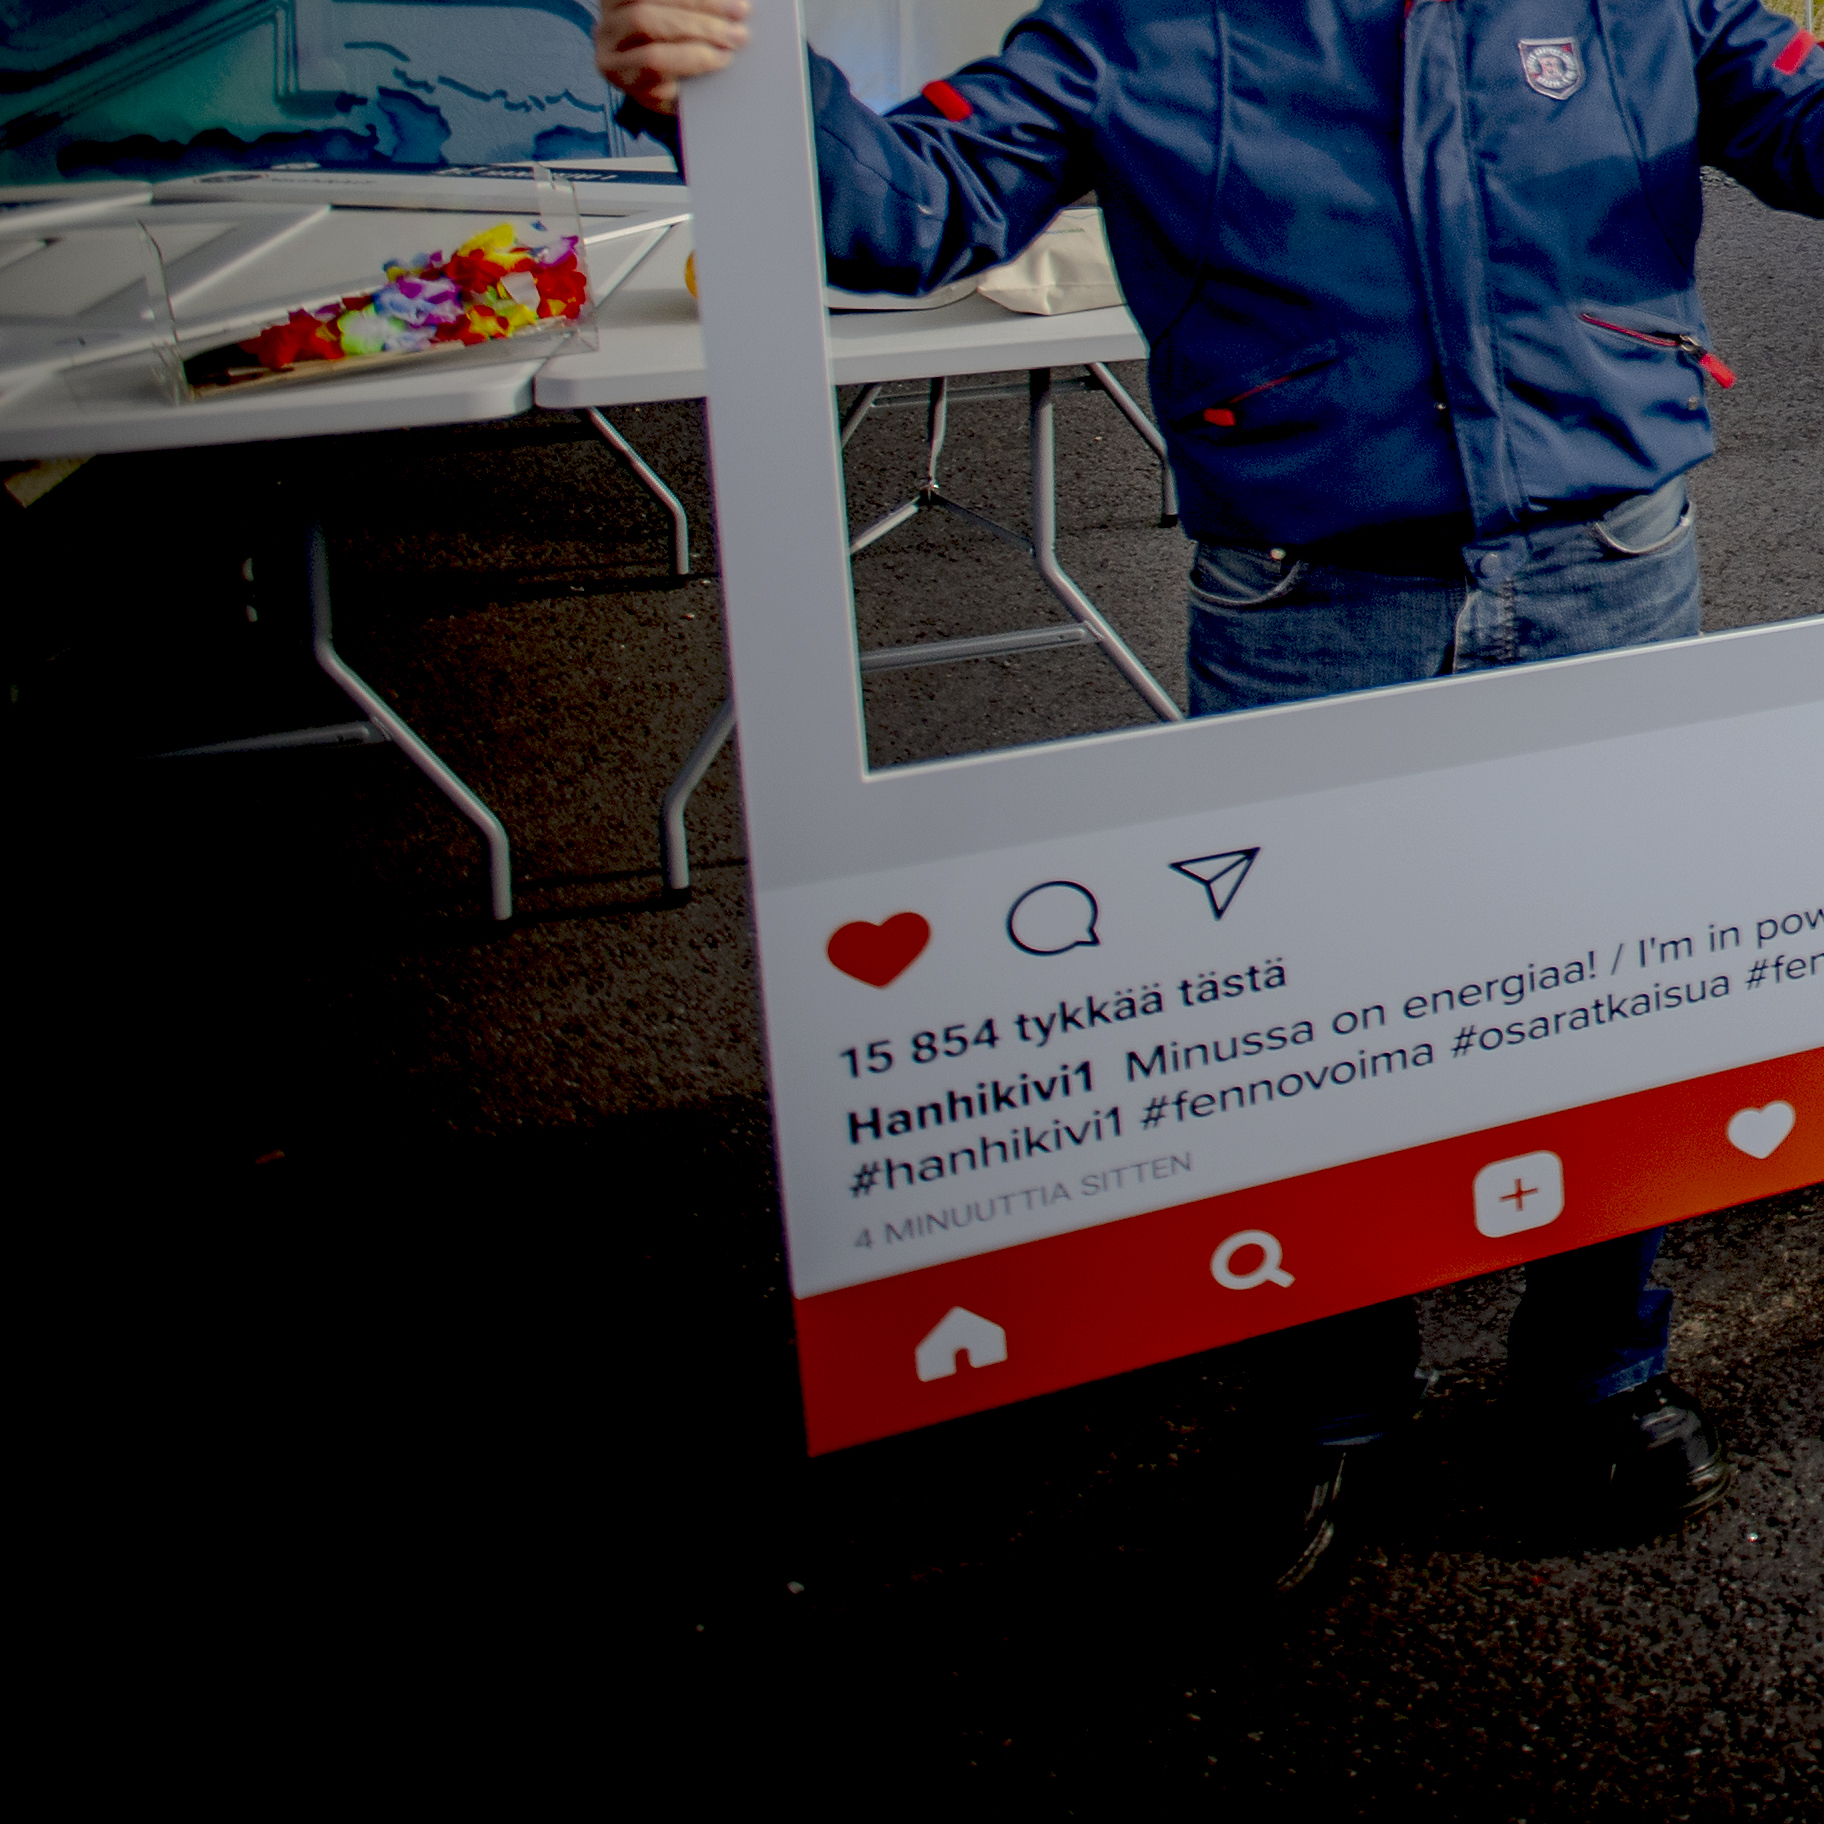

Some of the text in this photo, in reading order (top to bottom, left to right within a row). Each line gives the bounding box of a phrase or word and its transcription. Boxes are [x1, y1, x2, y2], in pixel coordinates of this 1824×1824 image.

[839, 956, 1288, 1079] 15 854 tykkää tästä
[846, 1060, 1095, 1145] Hanhikivi1
[1124, 1019, 1314, 1082] Minussa
[1331, 1002, 1386, 1036] on
[1402, 950, 1597, 1020] energiaa!
[1610, 942, 1625, 976] /
[1637, 934, 1693, 969] I'm
[1707, 922, 1741, 954] in
[849, 1106, 1122, 1199] #hanhikivi1
[1140, 1041, 1434, 1130] #fennovoima
[1450, 973, 1731, 1059] #osaratkaisua
[853, 1151, 1193, 1251] 4 MINUUTTIA SITTEN
